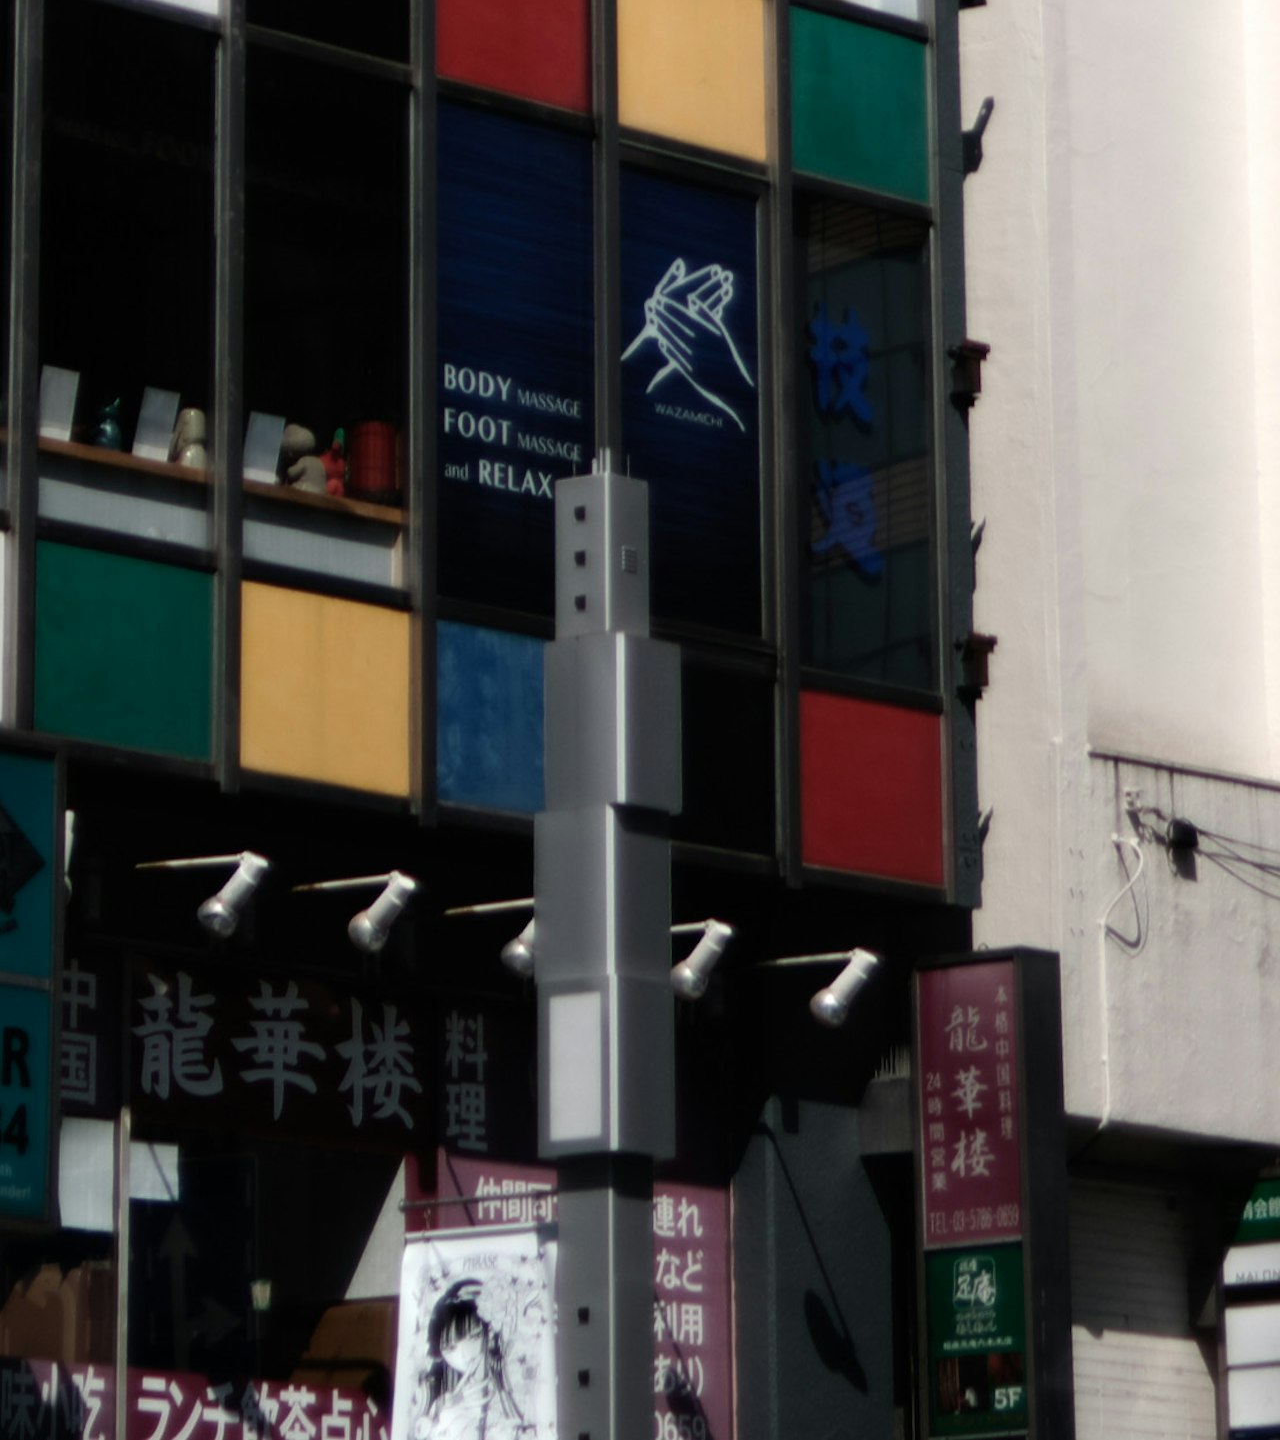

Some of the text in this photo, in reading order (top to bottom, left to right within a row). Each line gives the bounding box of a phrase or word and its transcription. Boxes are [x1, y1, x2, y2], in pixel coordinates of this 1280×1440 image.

[444, 363, 581, 419] BODY MASSAGE
[654, 402, 723, 428] WAZAMICHI
[444, 407, 581, 462] FOOT MASSAGE
[444, 459, 552, 499] and RELAX
[131, 970, 423, 1131] 龍華楼
[445, 1009, 488, 1153] 料理
[944, 1003, 996, 1178] 龍華楼
[474, 1174, 557, 1220] 仲間同
[994, 1386, 1023, 1410] 5F
